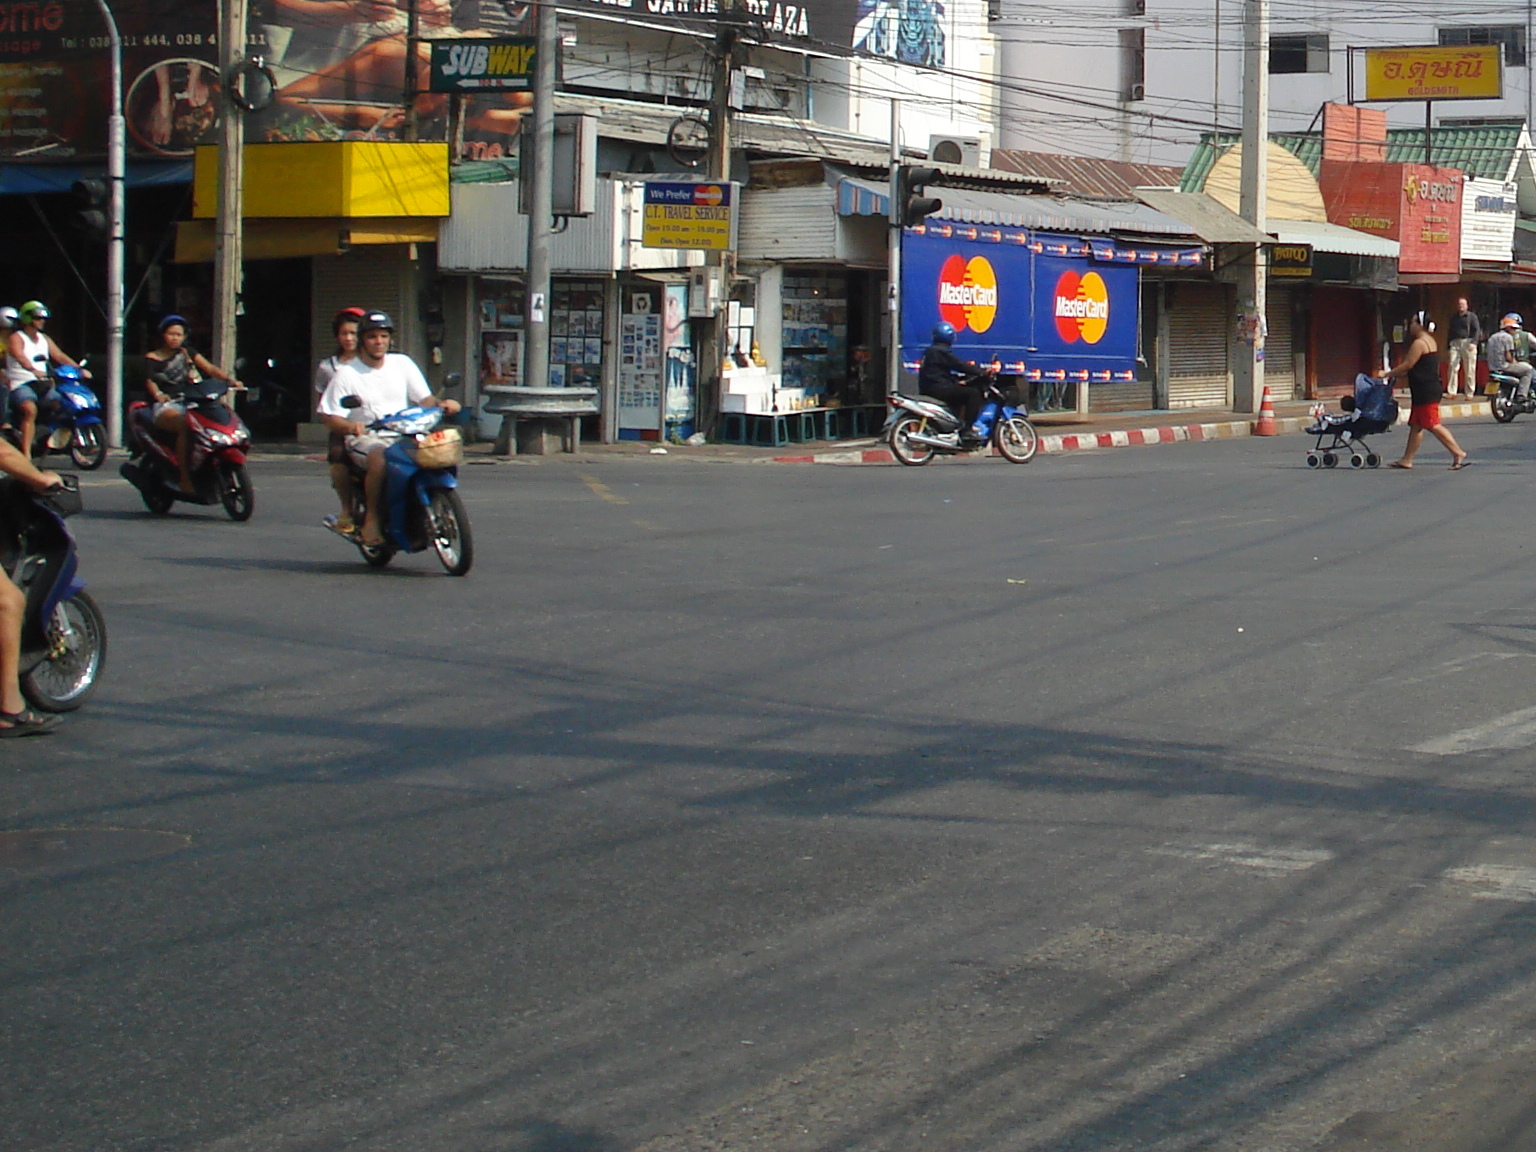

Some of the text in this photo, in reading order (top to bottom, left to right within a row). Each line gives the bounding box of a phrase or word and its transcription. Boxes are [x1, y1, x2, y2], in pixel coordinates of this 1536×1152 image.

[440, 45, 535, 75] SUBWAY
[664, 205, 693, 220] TRAVEL
[694, 206, 729, 221] SERVICE
[939, 280, 998, 308] MasterCard
[1054, 295, 1109, 320] MasterCard
